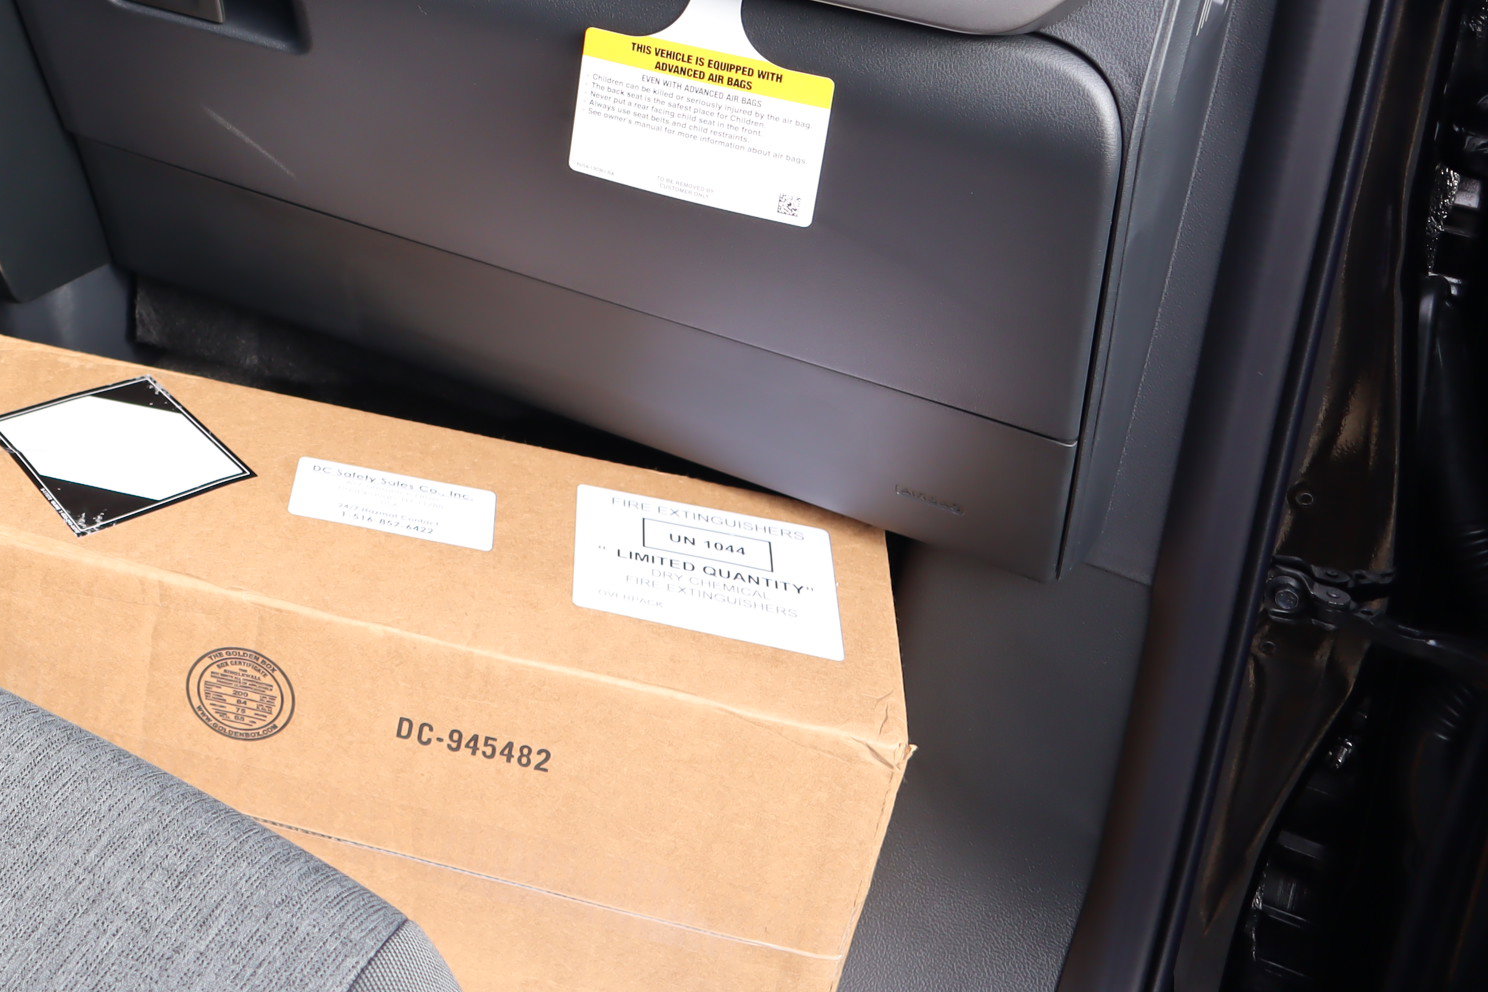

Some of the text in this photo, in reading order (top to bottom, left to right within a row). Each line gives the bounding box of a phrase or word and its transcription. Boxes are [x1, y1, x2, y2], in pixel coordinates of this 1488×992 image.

[630, 42, 783, 84] THIS VEHICLE IS EQUIPPED WITH
[654, 60, 752, 90] ADVANCED AIR BAGS
[591, 82, 605, 91] The
[606, 85, 624, 96] back
[626, 90, 642, 100] seat
[644, 94, 651, 102] is
[652, 96, 665, 105] the
[667, 99, 691, 111] safest
[692, 105, 714, 118] place
[716, 110, 728, 120] for
[592, 73, 623, 87] Children
[625, 81, 639, 90] can
[641, 84, 651, 93] be
[652, 87, 673, 98] killed
[675, 92, 684, 100] or
[685, 94, 722, 111] seriously
[723, 103, 752, 117] injured
[754, 109, 764, 120] by
[766, 112, 779, 122] the
[782, 116, 792, 125] air
[641, 74, 762, 108] EVEN WITH ADVANCED AIR BAGS
[588, 99, 615, 113] Always
[617, 106, 631, 115] use
[632, 109, 648, 120] seat
[650, 113, 670, 124] belts
[671, 118, 686, 128] and
[688, 122, 708, 133] child
[589, 90, 612, 102] Never
[613, 96, 625, 107] put
[634, 100, 648, 111] rear
[650, 104, 675, 118] facing
[676, 110, 696, 122] child
[698, 115, 715, 126] seat
[717, 120, 724, 128] in
[726, 122, 739, 131] the
[587, 108, 601, 117] See
[634, 119, 662, 132] manual
[664, 126, 675, 135] for
[677, 129, 697, 140] more
[699, 134, 745, 151] information
[747, 145, 771, 157] about
[772, 151, 783, 160] air
[312, 464, 331, 474] DC
[336, 469, 375, 483] Safety
[380, 477, 413, 489] Sales
[611, 496, 805, 541] FIRE EXTINGUISHERS
[616, 548, 695, 572] LIMITED
[669, 533, 746, 555] UN 1044
[598, 588, 663, 608] OVERPACK
[626, 575, 798, 617] FIRE EXTINGUISHERS
[651, 568, 769, 599] DRY CHEMICAL
[207, 652, 224, 661] THE
[225, 650, 260, 662] GOLDEN
[260, 659, 278, 674] BOX
[230, 660, 268, 678] CERTIFICATE
[396, 717, 552, 773] DC-945482
